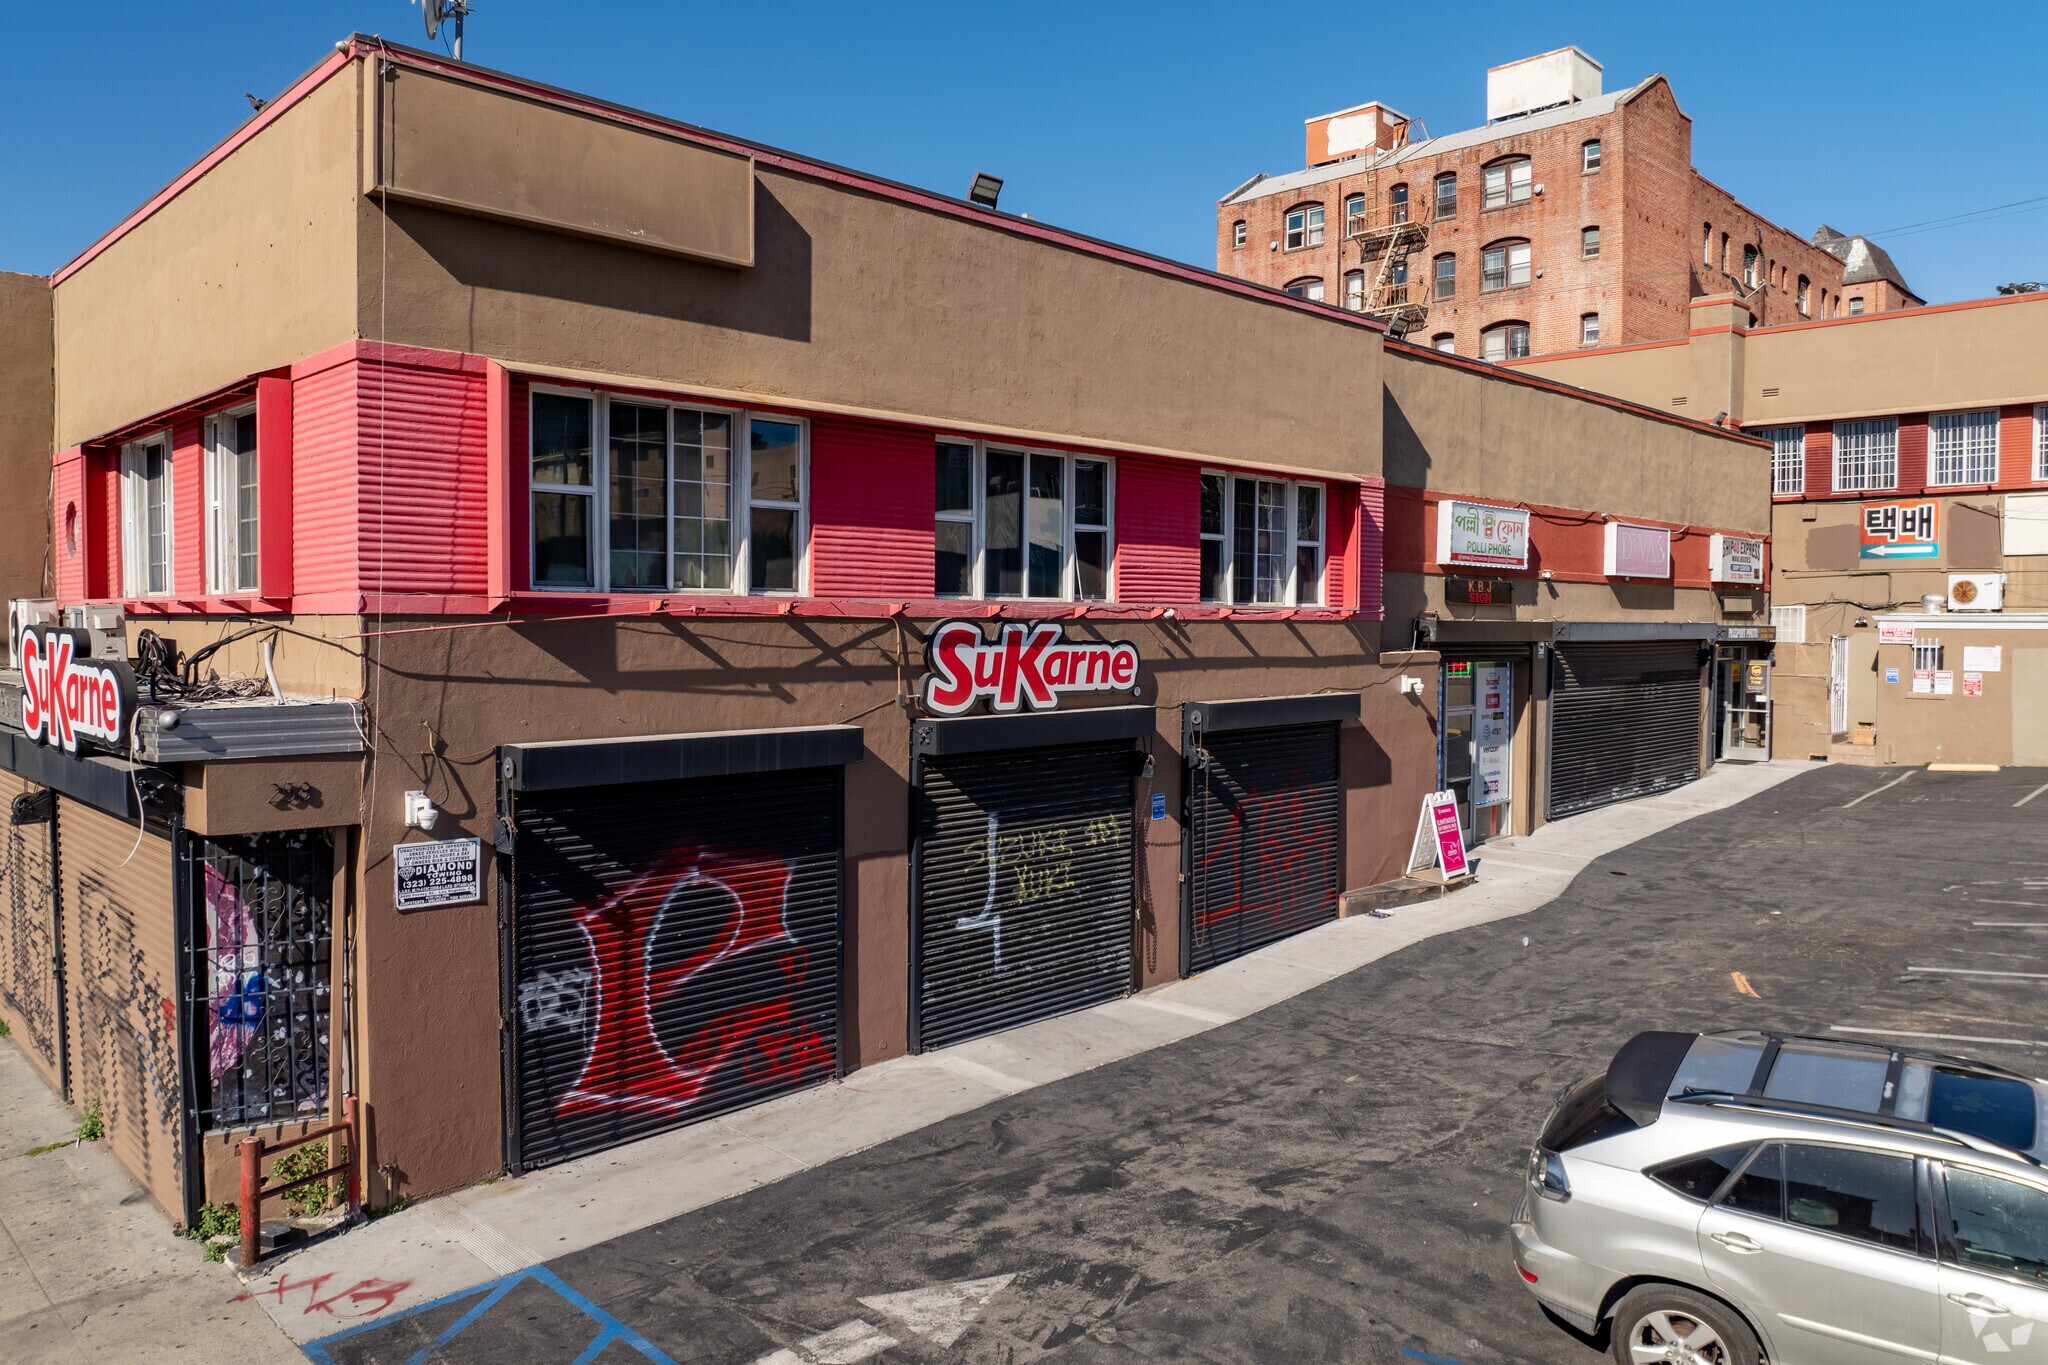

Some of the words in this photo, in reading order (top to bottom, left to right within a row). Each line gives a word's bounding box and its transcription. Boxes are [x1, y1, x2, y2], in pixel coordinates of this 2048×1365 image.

[1455, 507, 1479, 536] পল্লী
[1497, 520, 1525, 544] ফোন
[1866, 506, 1932, 540] 택배
[1467, 541, 1487, 554] POLLI
[1488, 543, 1512, 556] PHONE
[1740, 542, 1760, 562] EXPRESS
[1469, 593, 1491, 604] SIGN
[933, 630, 1134, 706] SuKarne
[23, 636, 118, 744] SuKarne
[1483, 745, 1500, 753] verizon
[415, 861, 472, 876] DIAMOND
[426, 870, 462, 879] TOWING
[403, 880, 427, 889] (323)
[429, 874, 473, 886] 225-4898
